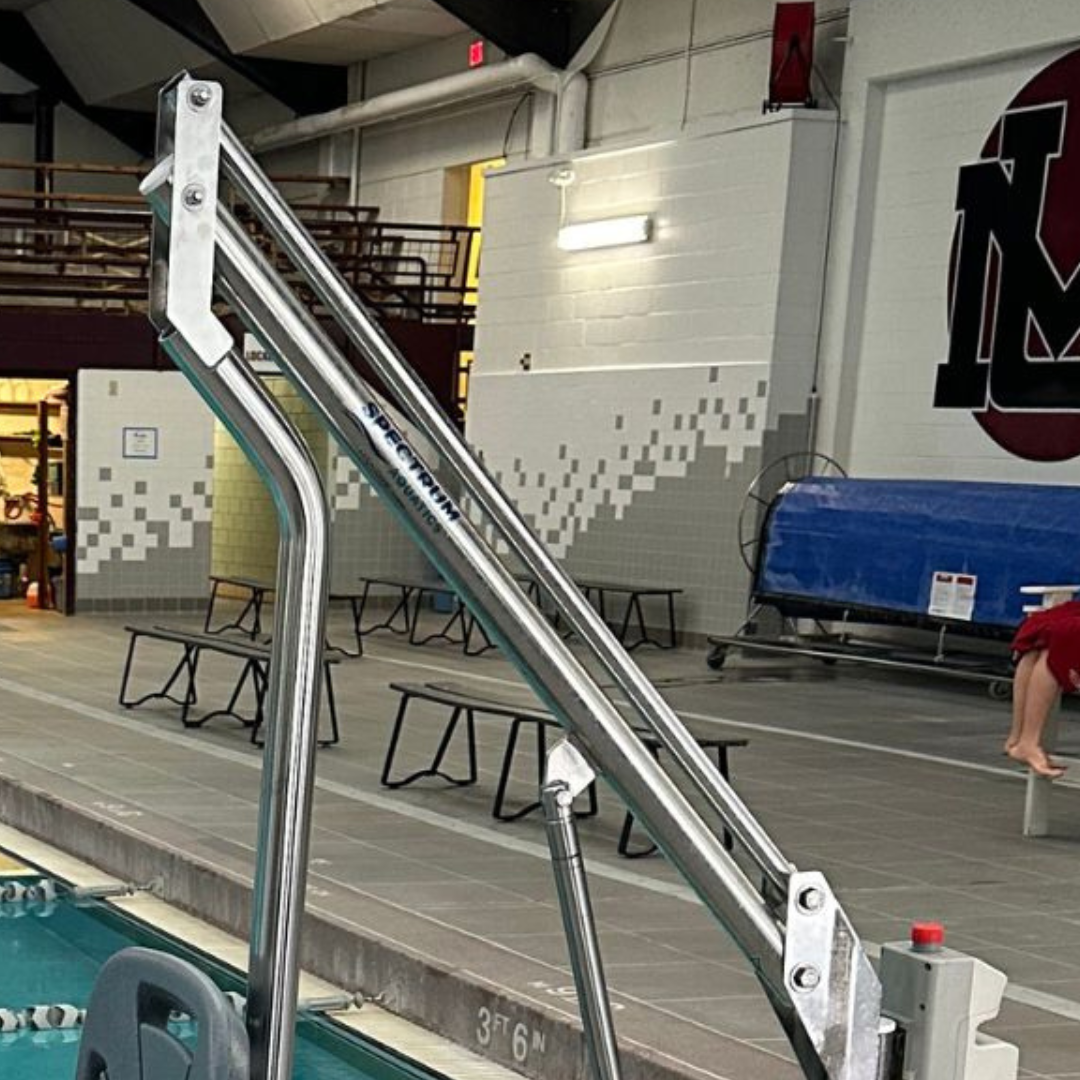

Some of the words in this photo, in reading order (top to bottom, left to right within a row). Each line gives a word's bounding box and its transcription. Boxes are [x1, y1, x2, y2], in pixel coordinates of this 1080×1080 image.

[363, 402, 460, 521] SPECTRUM
[389, 468, 440, 533] AQUATICS
[476, 1006, 491, 1046] 3
[492, 1012, 510, 1035] FT
[512, 1022, 528, 1062] 6
[532, 1030, 545, 1053] IN
